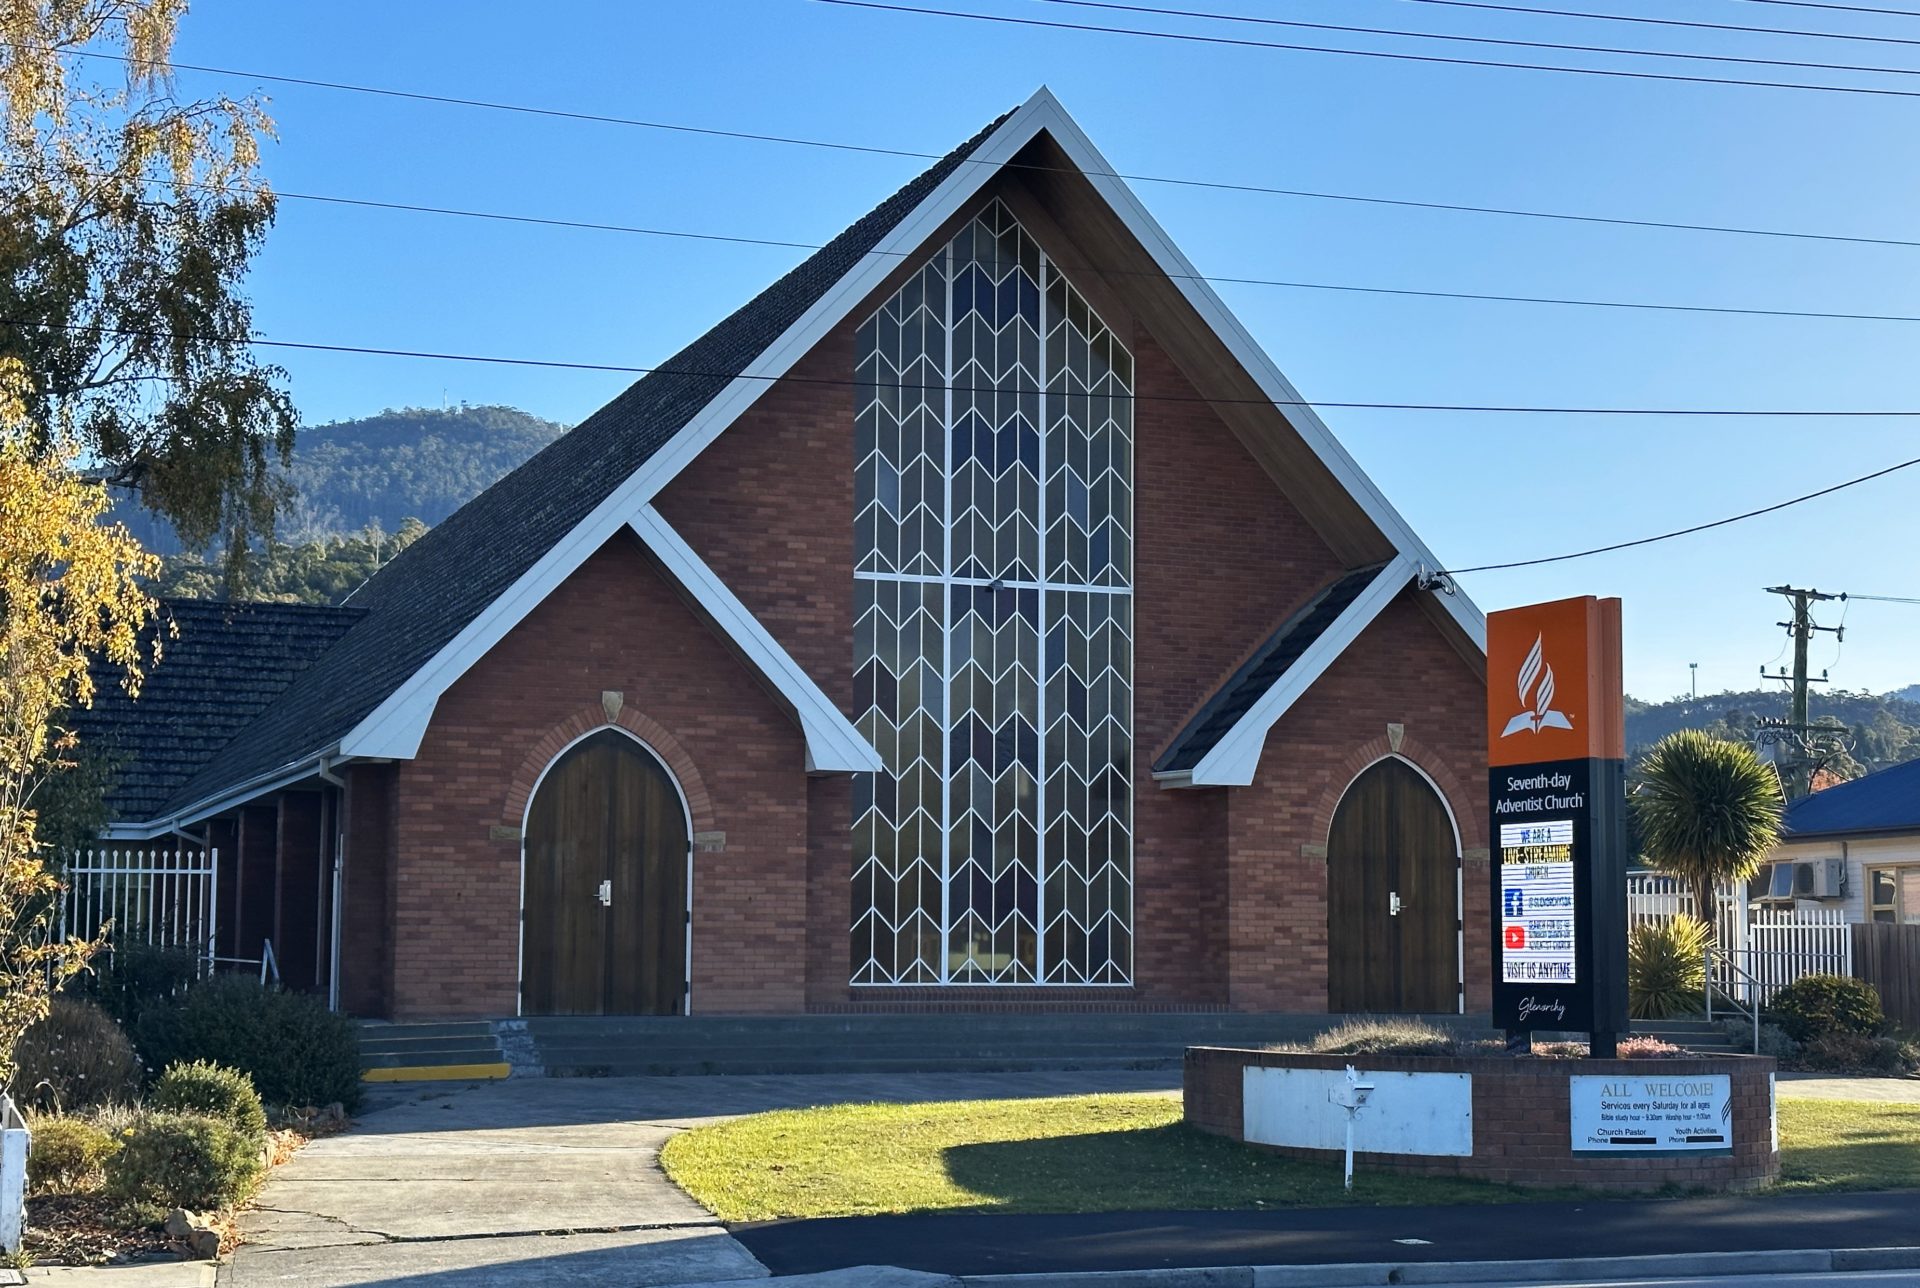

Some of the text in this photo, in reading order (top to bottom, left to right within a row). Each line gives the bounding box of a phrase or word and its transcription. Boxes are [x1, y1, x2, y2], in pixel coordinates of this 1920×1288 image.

[1507, 772, 1571, 791] Seventh-day
[1495, 792, 1583, 814] Adventist Church
[1533, 828, 1545, 843] ARE
[1547, 827, 1552, 842] A
[1503, 844, 1571, 865] LIVE-STREAMING
[1525, 865, 1549, 880] CHURCH
[1506, 961, 1572, 979] VISIT US ANYTIME
[1518, 995, 1566, 1021] Glenorchy
[1600, 1082, 1714, 1097] ALL WELCOME!
[1601, 1100, 1631, 1110] Services
[1633, 1103, 1650, 1112] every
[1652, 1100, 1678, 1111] Saturday
[1680, 1100, 1688, 1109] for
[1698, 1102, 1711, 1111] ages
[1601, 1113, 1614, 1121] Bible
[1615, 1114, 1629, 1122] study
[1665, 1113, 1682, 1122] Worship
[1683, 1113, 1692, 1121] hour
[1597, 1128, 1647, 1136] Church Pastor
[1675, 1127, 1718, 1135] Youth Activities
[1588, 1136, 1609, 1144] Phone
